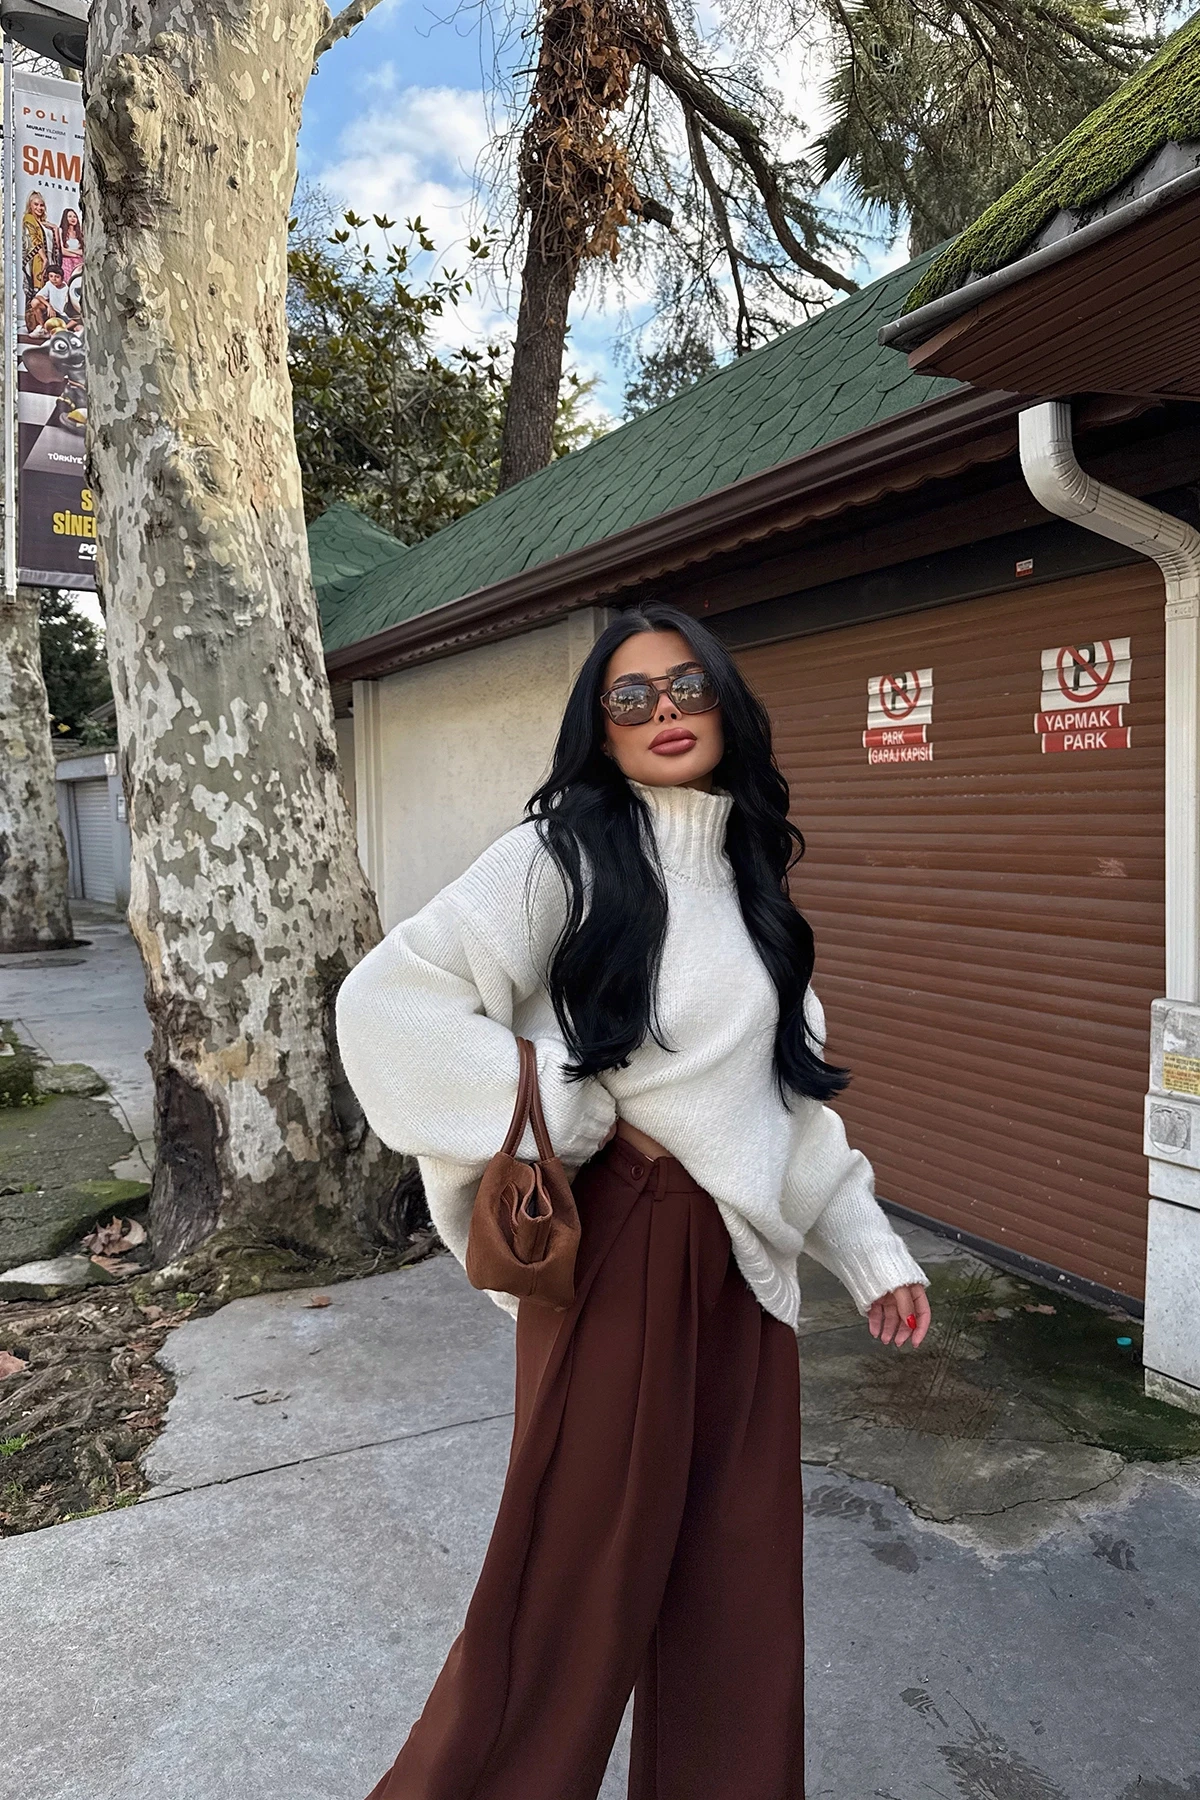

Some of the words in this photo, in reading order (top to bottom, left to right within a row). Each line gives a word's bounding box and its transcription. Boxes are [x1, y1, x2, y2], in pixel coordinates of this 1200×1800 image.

[23, 107, 69, 124] POLL
[1045, 710, 1111, 731] YAPMAK
[882, 730, 905, 746] PARK
[1063, 731, 1107, 751] PARK
[871, 747, 899, 764] GARAJ
[900, 745, 929, 763] KAPISI
